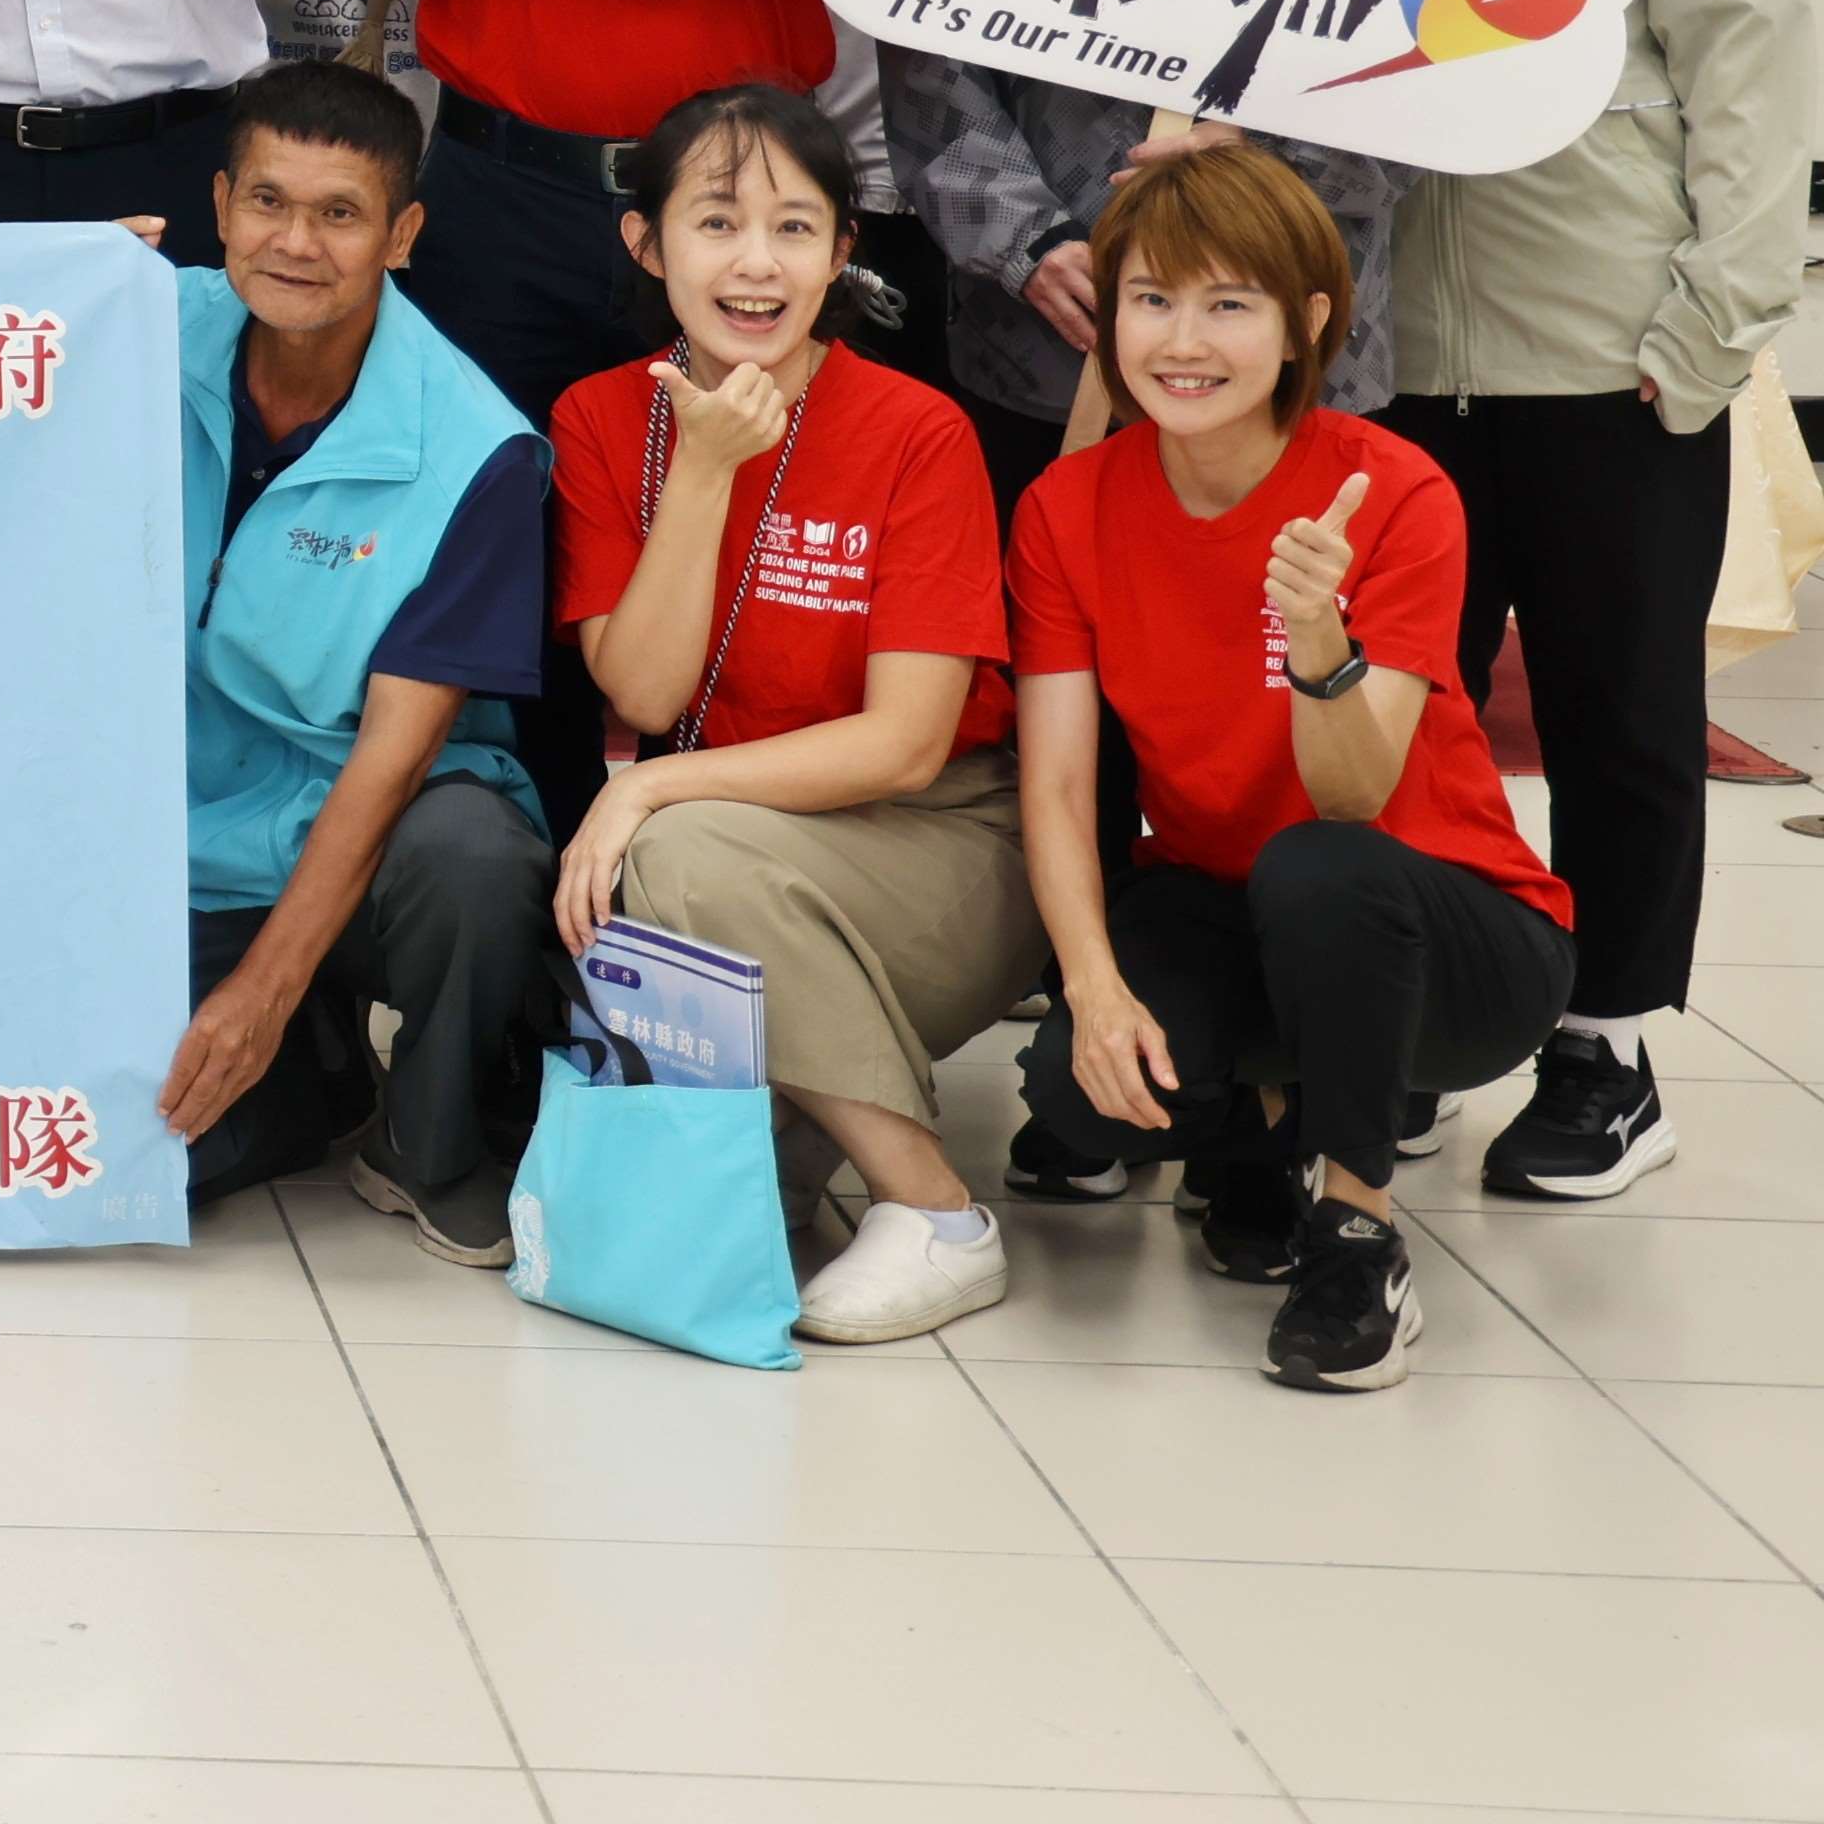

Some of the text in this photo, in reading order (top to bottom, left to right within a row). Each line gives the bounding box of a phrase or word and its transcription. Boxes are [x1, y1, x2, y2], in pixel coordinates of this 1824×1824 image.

[982, 8, 1069, 56] Our
[1078, 31, 1189, 85] Time
[803, 545, 831, 557] SDG4
[760, 553, 784, 567] 2024
[786, 558, 808, 573] ONE
[759, 570, 829, 592] READING AND
[833, 600, 870, 614] MARKE
[607, 1008, 715, 1066] 雲林縣政府
